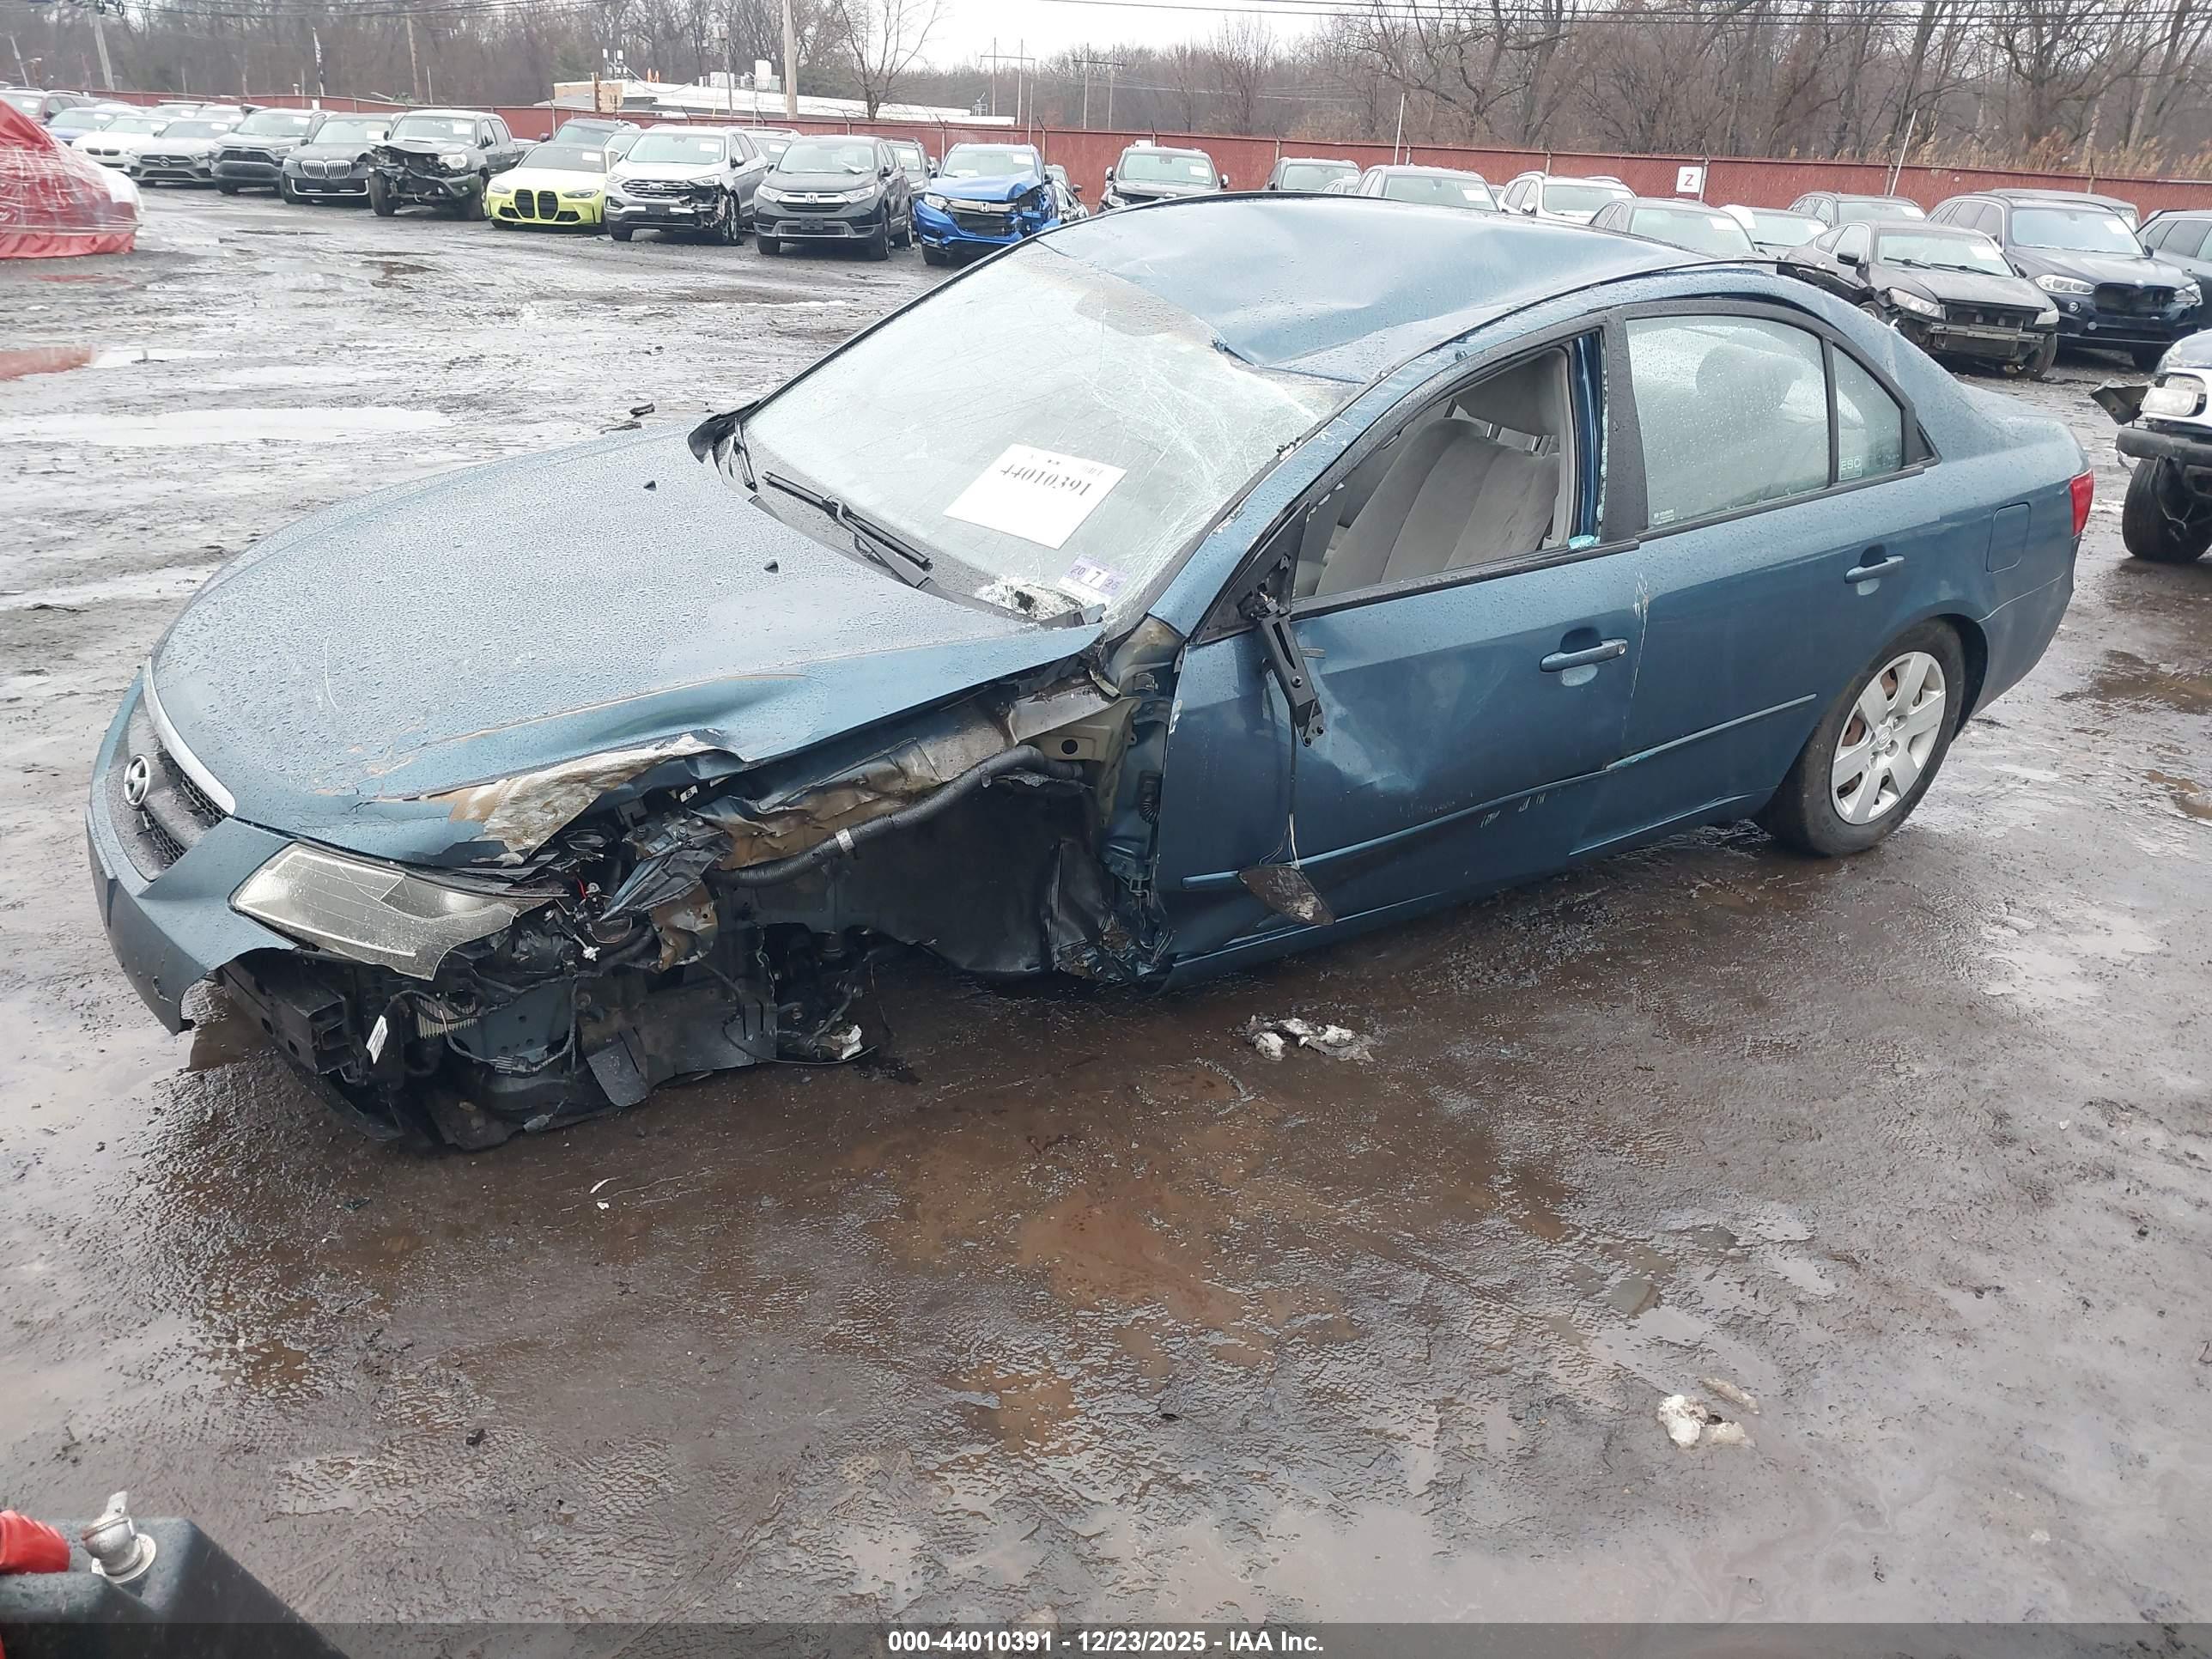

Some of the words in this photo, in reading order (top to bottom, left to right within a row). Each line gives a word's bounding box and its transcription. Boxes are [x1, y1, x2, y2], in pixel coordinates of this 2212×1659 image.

[1684, 173, 1694, 186] Z
[1000, 464, 1091, 495] 44010391
[1089, 570, 1102, 583] 7
